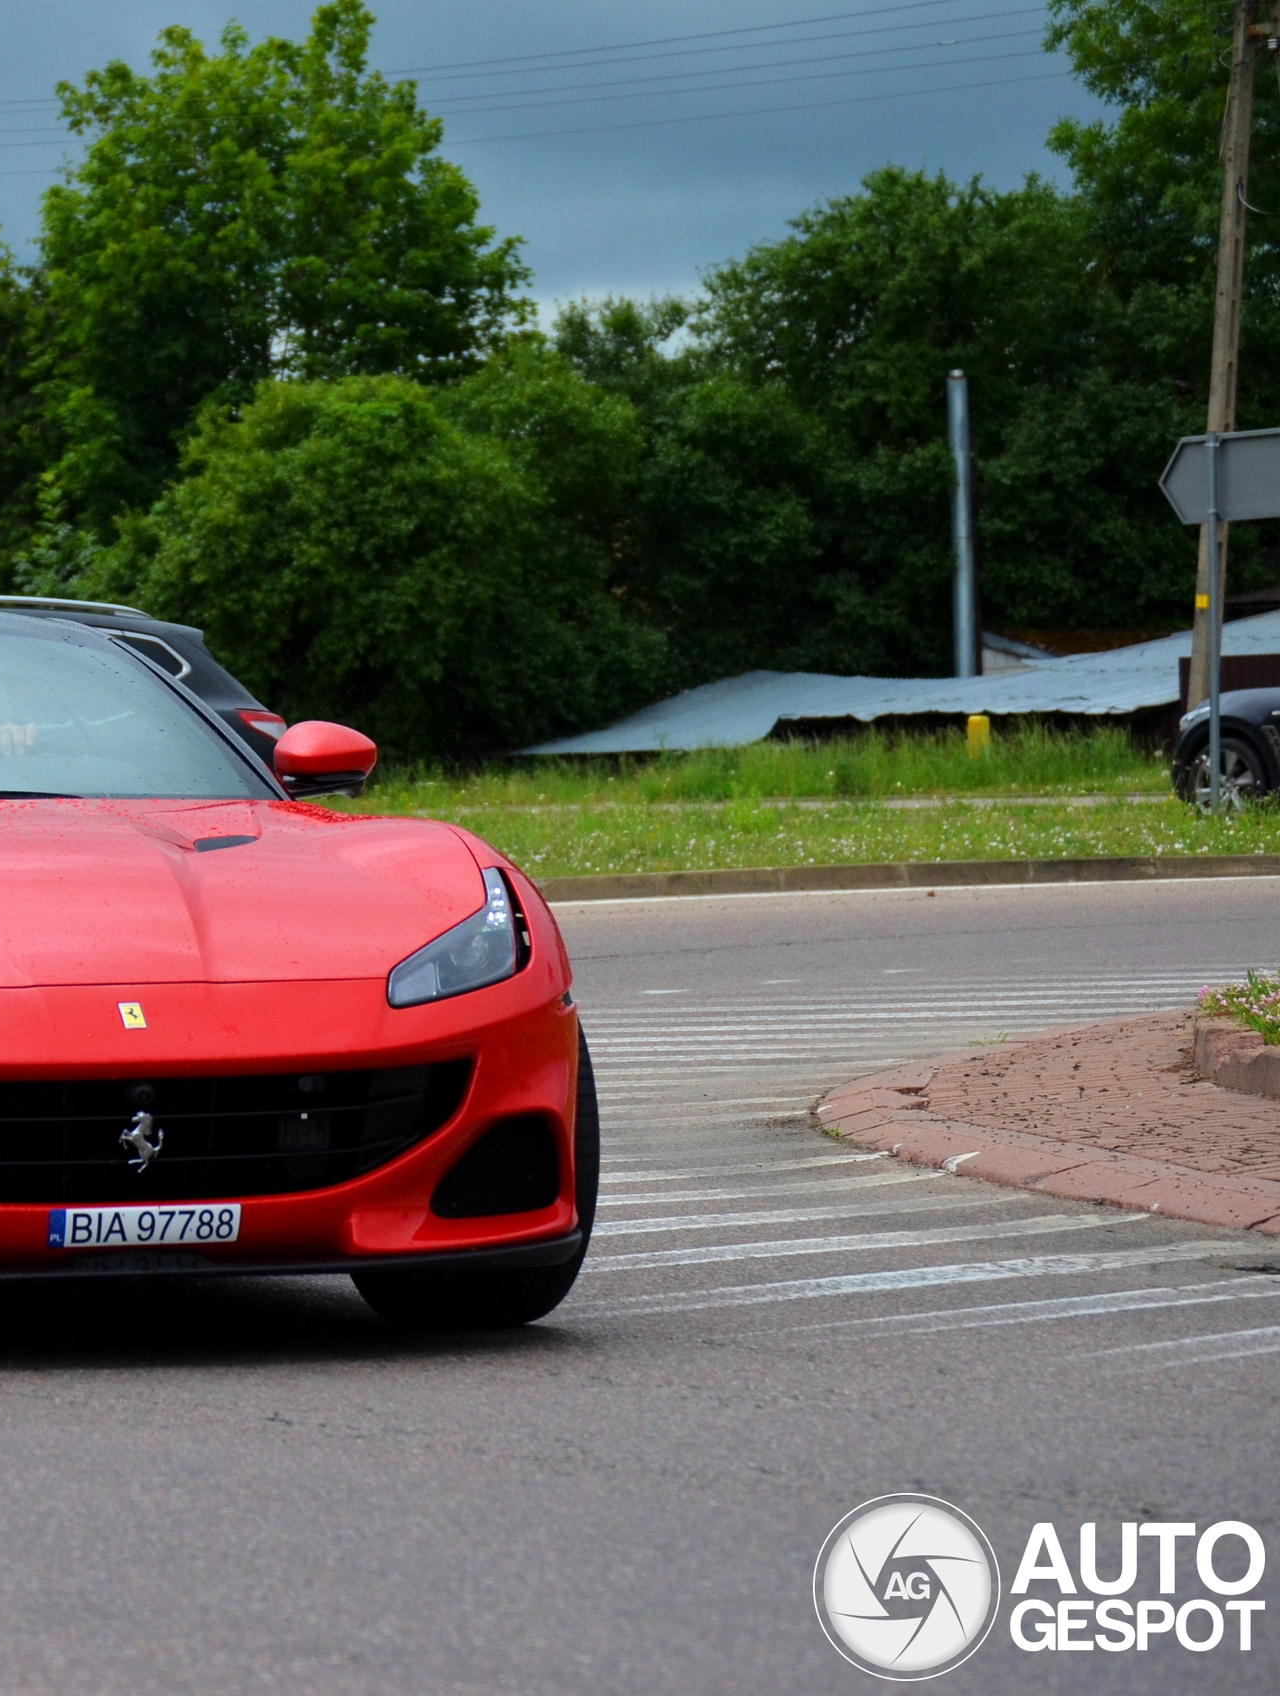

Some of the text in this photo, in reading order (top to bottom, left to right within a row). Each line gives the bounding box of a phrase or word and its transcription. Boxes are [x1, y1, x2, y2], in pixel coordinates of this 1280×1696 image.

[71, 1208, 234, 1244] BIA 97788
[50, 1233, 62, 1242] PL
